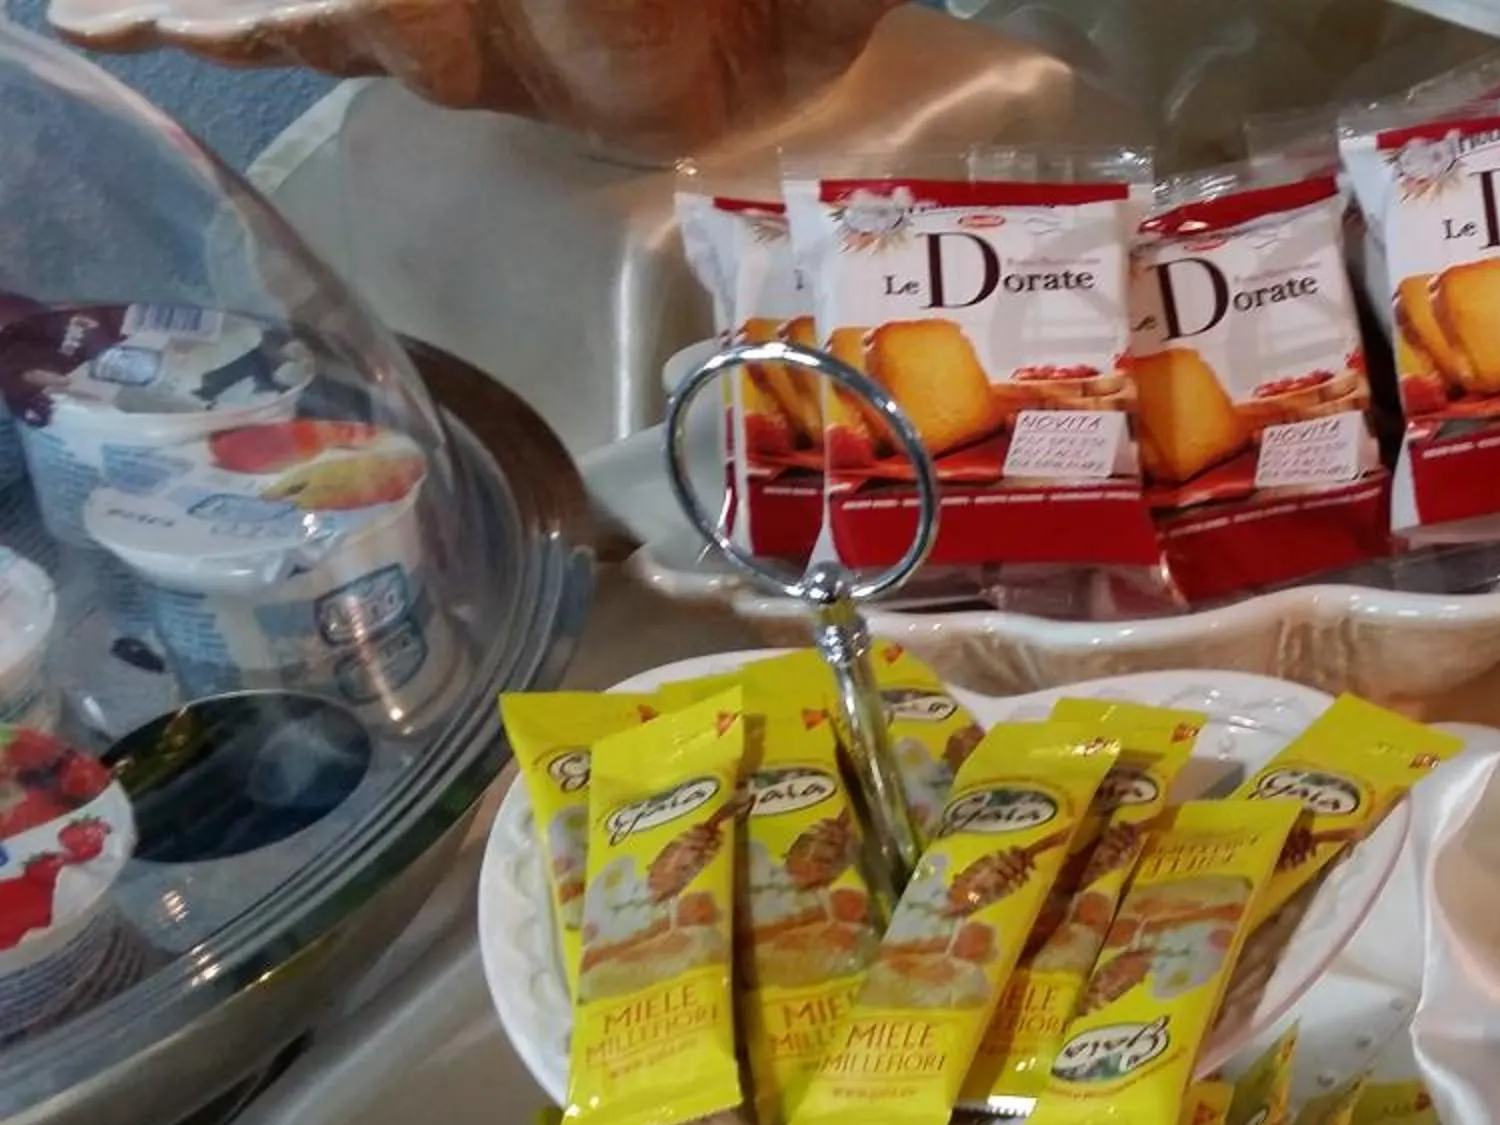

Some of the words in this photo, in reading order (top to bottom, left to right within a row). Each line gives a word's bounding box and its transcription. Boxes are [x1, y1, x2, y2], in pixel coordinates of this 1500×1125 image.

[1442, 218, 1477, 241] Le
[883, 274, 920, 296] Le
[914, 230, 1095, 310] Dorate
[1145, 256, 1319, 343] Dorate
[603, 981, 698, 1036] MIELE
[845, 1022, 936, 1049] MIELE
